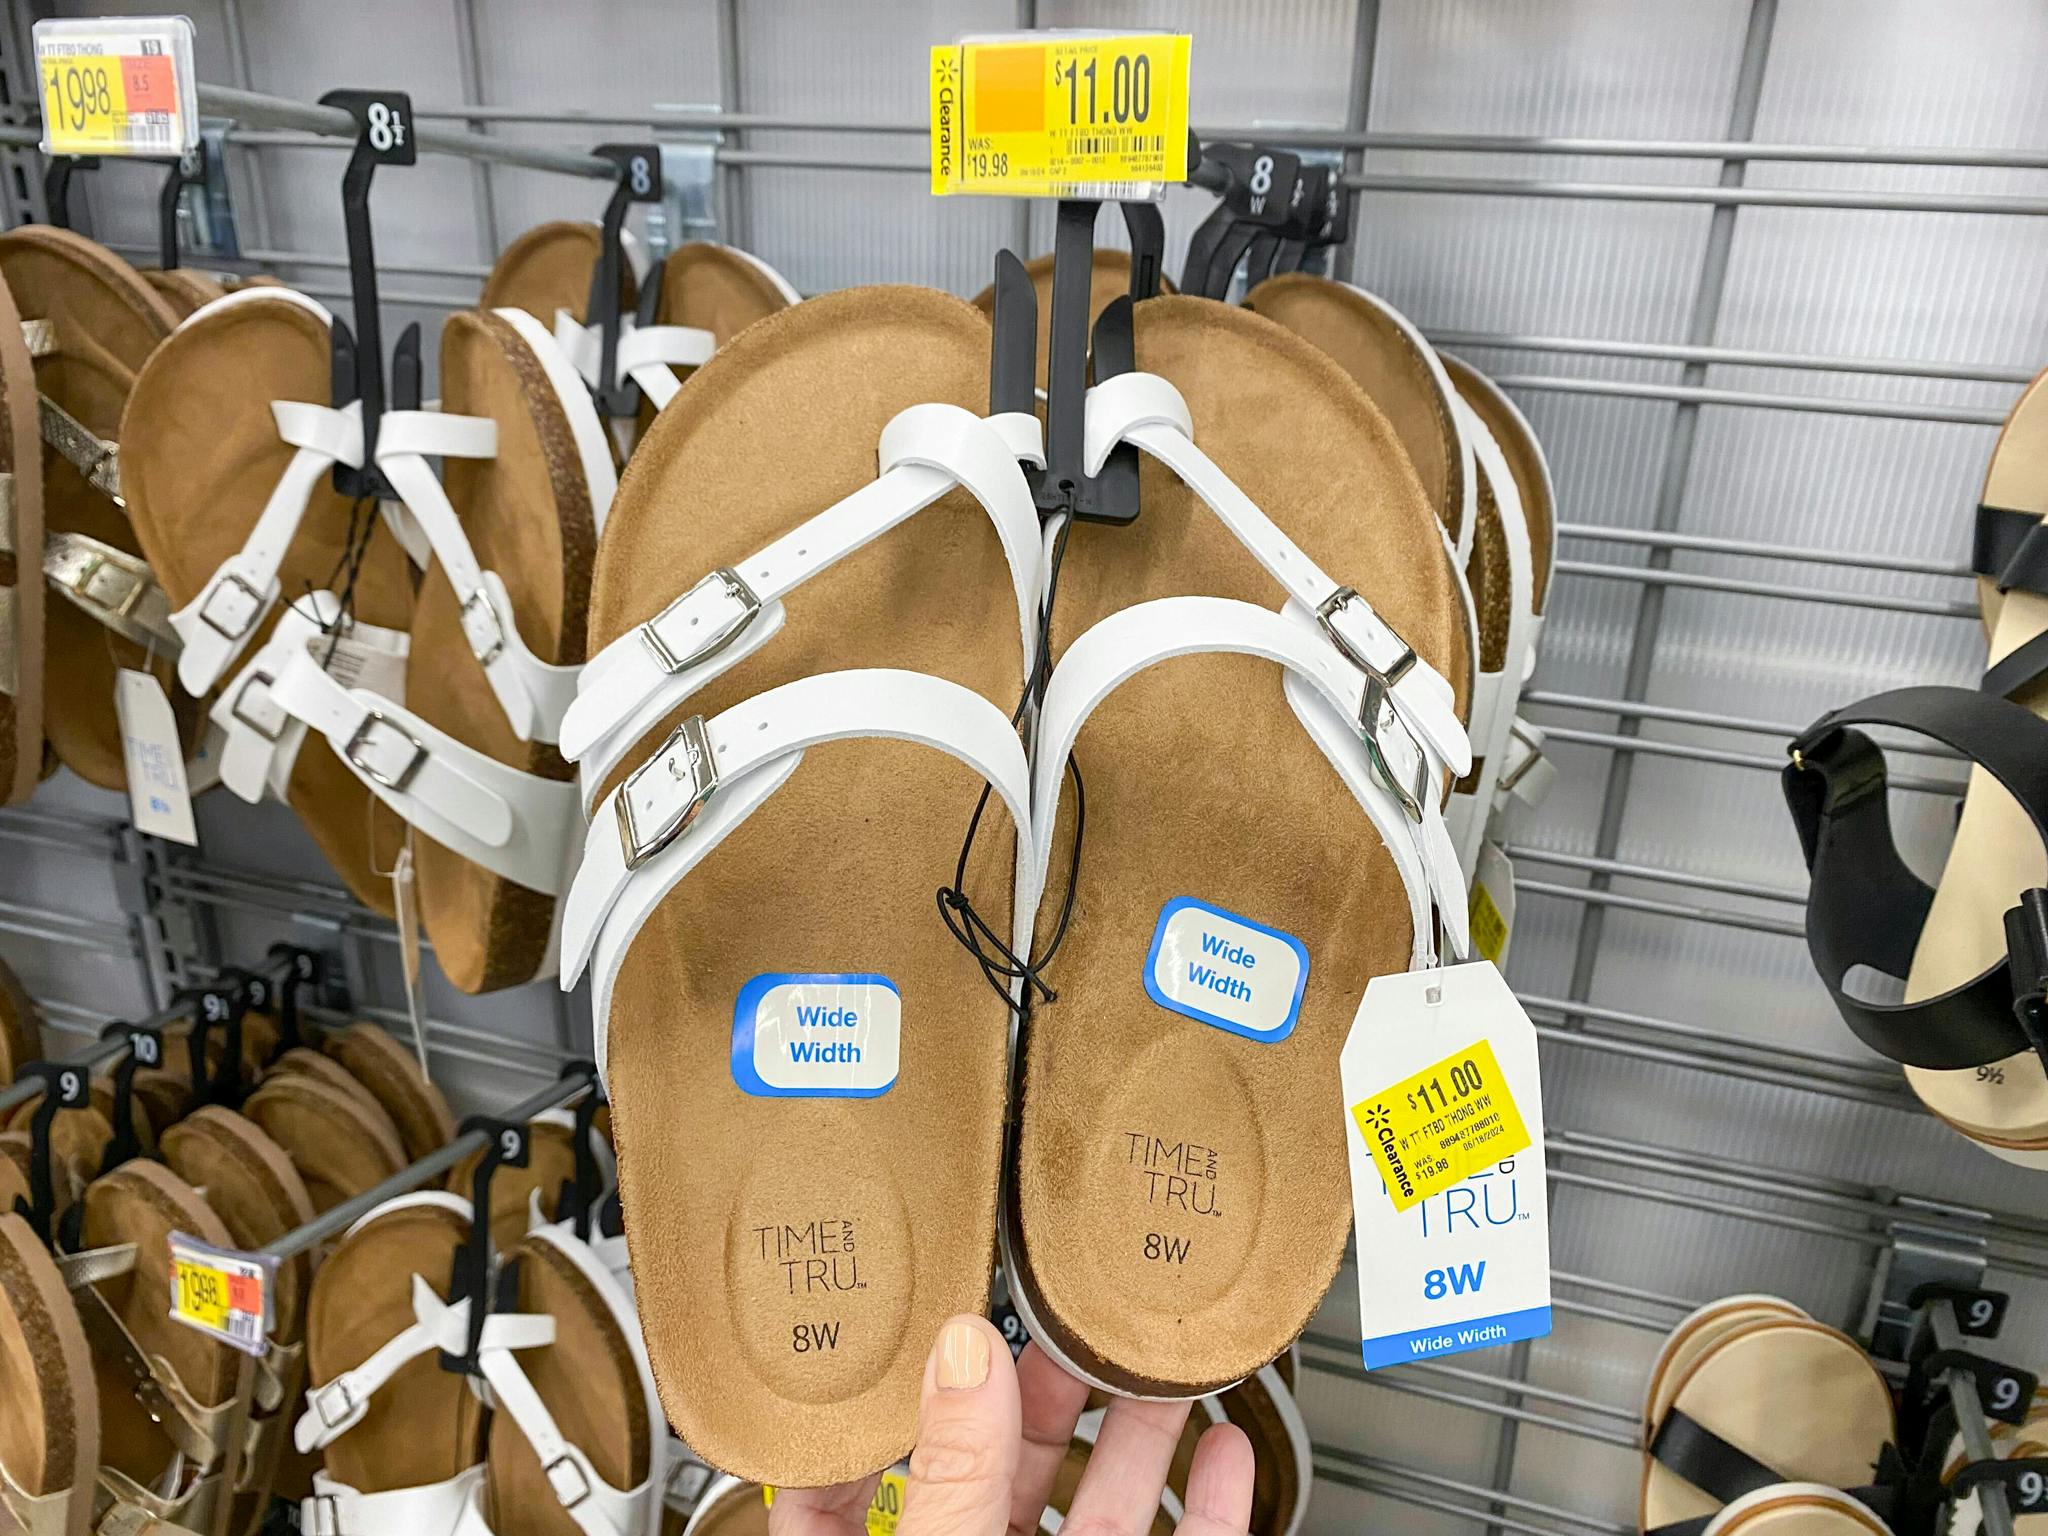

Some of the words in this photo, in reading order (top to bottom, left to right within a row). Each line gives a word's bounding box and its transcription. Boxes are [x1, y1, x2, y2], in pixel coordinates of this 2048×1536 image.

[1055, 54, 1150, 125] $11.00
[939, 88, 954, 176] Clearance
[1092, 128, 1117, 136] THONG
[631, 155, 650, 195] 8
[967, 153, 1008, 177] $19.98
[1250, 155, 1275, 195] 8
[1250, 194, 1267, 216] W
[1200, 932, 1256, 969] Wide
[1188, 961, 1252, 1003] Width
[796, 1006, 858, 1027] Wide
[130, 1033, 159, 1064] 10
[789, 1041, 861, 1063] Width
[59, 1071, 80, 1102] 9
[1406, 1059, 1484, 1114] $11.00
[1399, 1137, 1410, 1152] W
[1410, 1129, 1422, 1146] TT
[1422, 1118, 1446, 1140] FTBD
[1447, 1108, 1475, 1128] THONG
[1476, 1094, 1493, 1113] WW
[1463, 1124, 1505, 1152] 06/18/2024
[501, 1129, 522, 1161] 9
[1124, 1132, 1205, 1177] TIME
[1205, 1148, 1218, 1180] AND
[1377, 1127, 1415, 1198] Clearance
[1415, 1158, 1450, 1182] $19.98
[1144, 1170, 1215, 1215] TRU
[752, 1220, 840, 1260] TIME
[842, 1220, 855, 1252] AND
[1143, 1233, 1191, 1265] 8W
[778, 1256, 857, 1295] TRU
[1424, 1261, 1486, 1300] 8W
[1968, 1299, 1994, 1328] 9
[792, 1321, 841, 1353] 8W
[1409, 1335, 1453, 1354] Wide
[1458, 1324, 1507, 1345] Width
[1991, 1377, 2020, 1411] 9
[2020, 1471, 2048, 1507] 9
